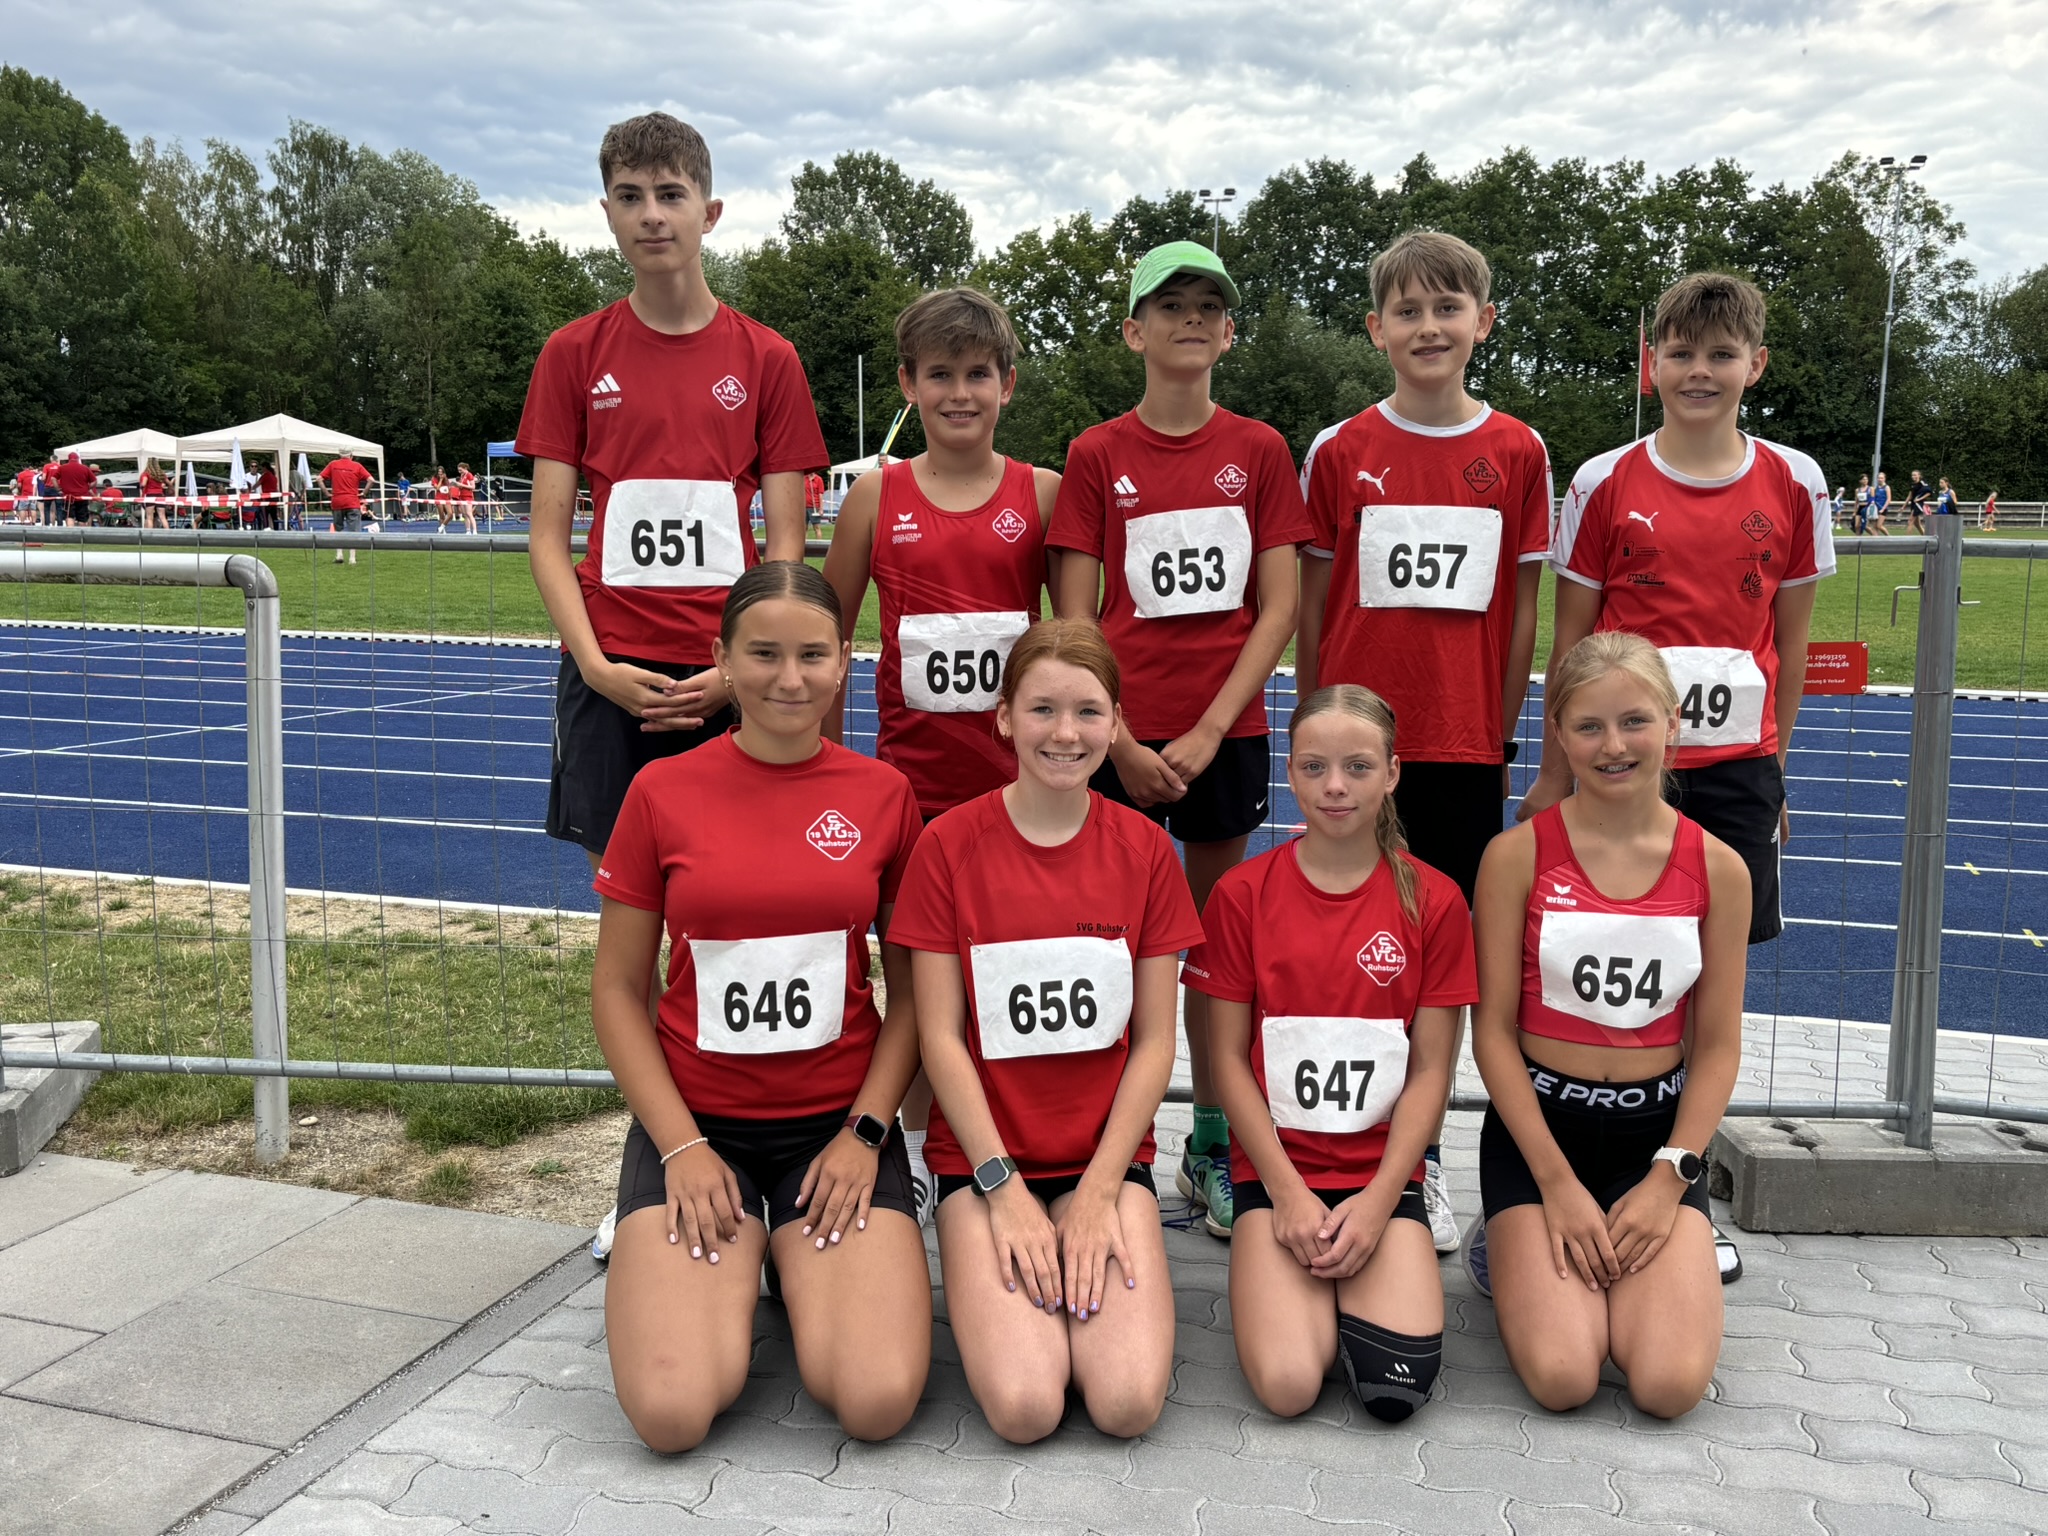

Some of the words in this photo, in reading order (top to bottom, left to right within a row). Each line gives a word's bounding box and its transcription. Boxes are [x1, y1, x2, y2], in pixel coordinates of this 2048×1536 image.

[631, 519, 705, 567] 651
[892, 522, 918, 531] erima
[1151, 546, 1226, 597] 653
[1388, 543, 1468, 590] 657
[926, 649, 1000, 694] 650
[1679, 683, 1732, 729] 49
[1546, 895, 1577, 907] erima
[1076, 922, 1094, 932] SVG
[1367, 963, 1400, 972] Ruhstorf
[1572, 954, 1663, 1009] 654
[723, 978, 812, 1033] 646
[1008, 978, 1098, 1035] 656
[1294, 1059, 1375, 1111] 647
[1559, 1082, 1646, 1108] PRO
